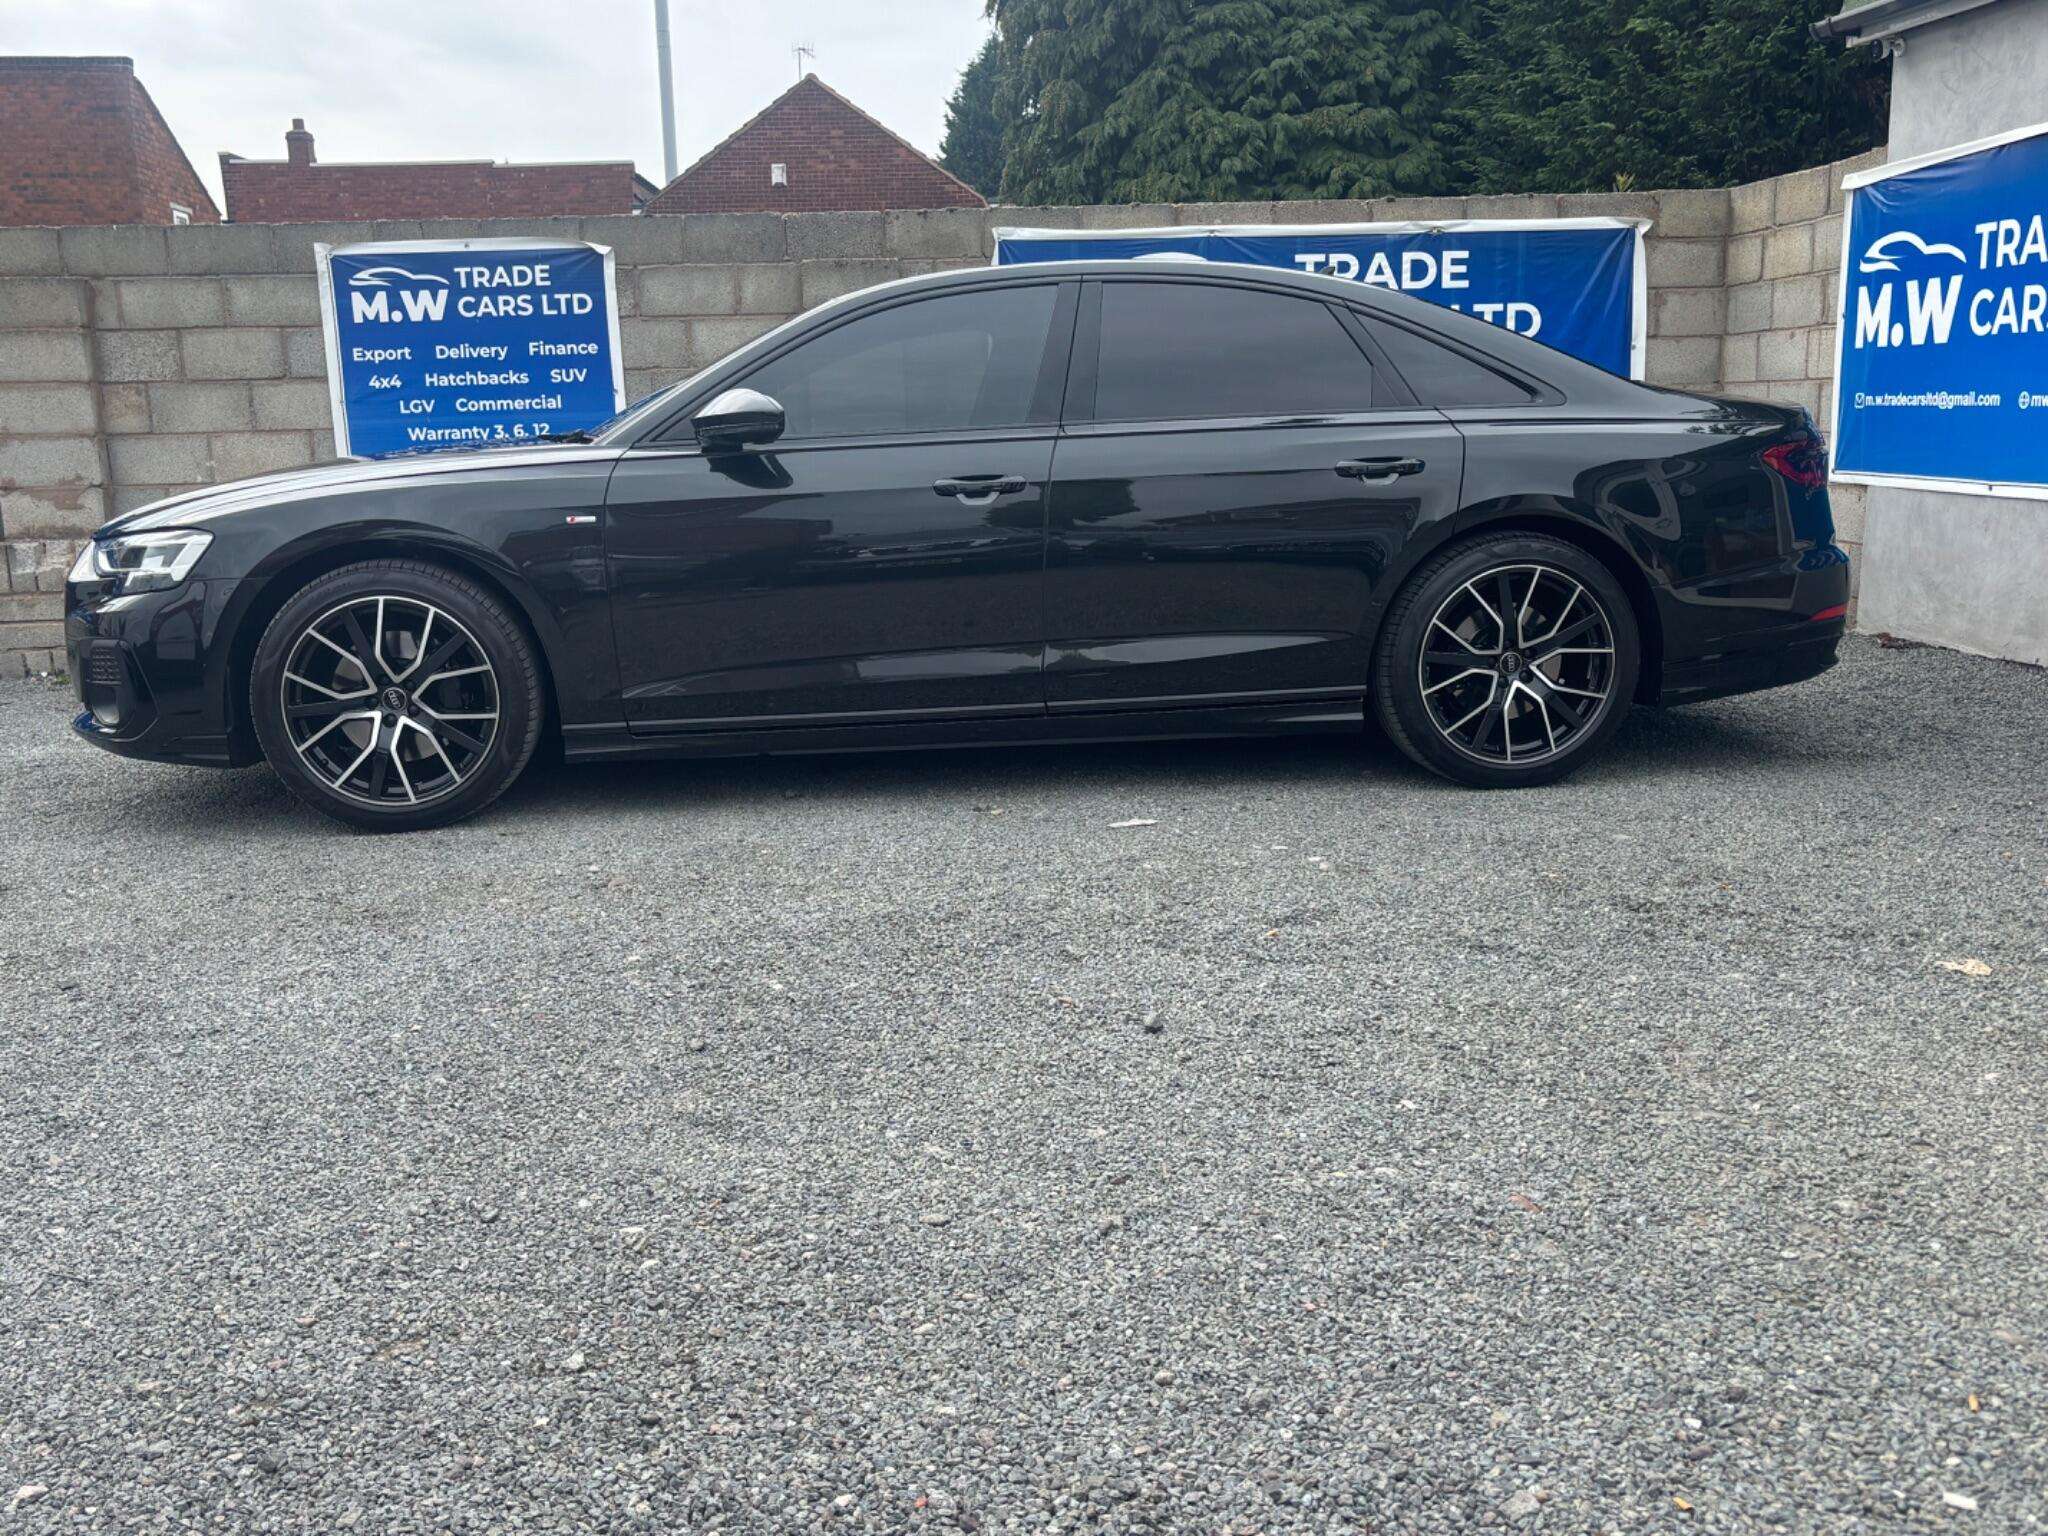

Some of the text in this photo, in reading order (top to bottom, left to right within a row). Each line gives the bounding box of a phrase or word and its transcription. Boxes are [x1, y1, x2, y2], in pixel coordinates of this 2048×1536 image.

[454, 264, 552, 289] TRADE
[350, 289, 449, 323] M.W
[457, 293, 593, 318] CARS LTD
[1855, 274, 1963, 349] M.W
[1969, 284, 2048, 336] CAR
[1450, 302, 1543, 338] TD
[352, 341, 599, 364] Export Delivery Finance
[368, 368, 587, 389] 4x4 Hatchbacks SUV
[400, 394, 562, 414] LGV Commercial
[407, 426, 490, 441] Warranty
[532, 422, 550, 436] 12
